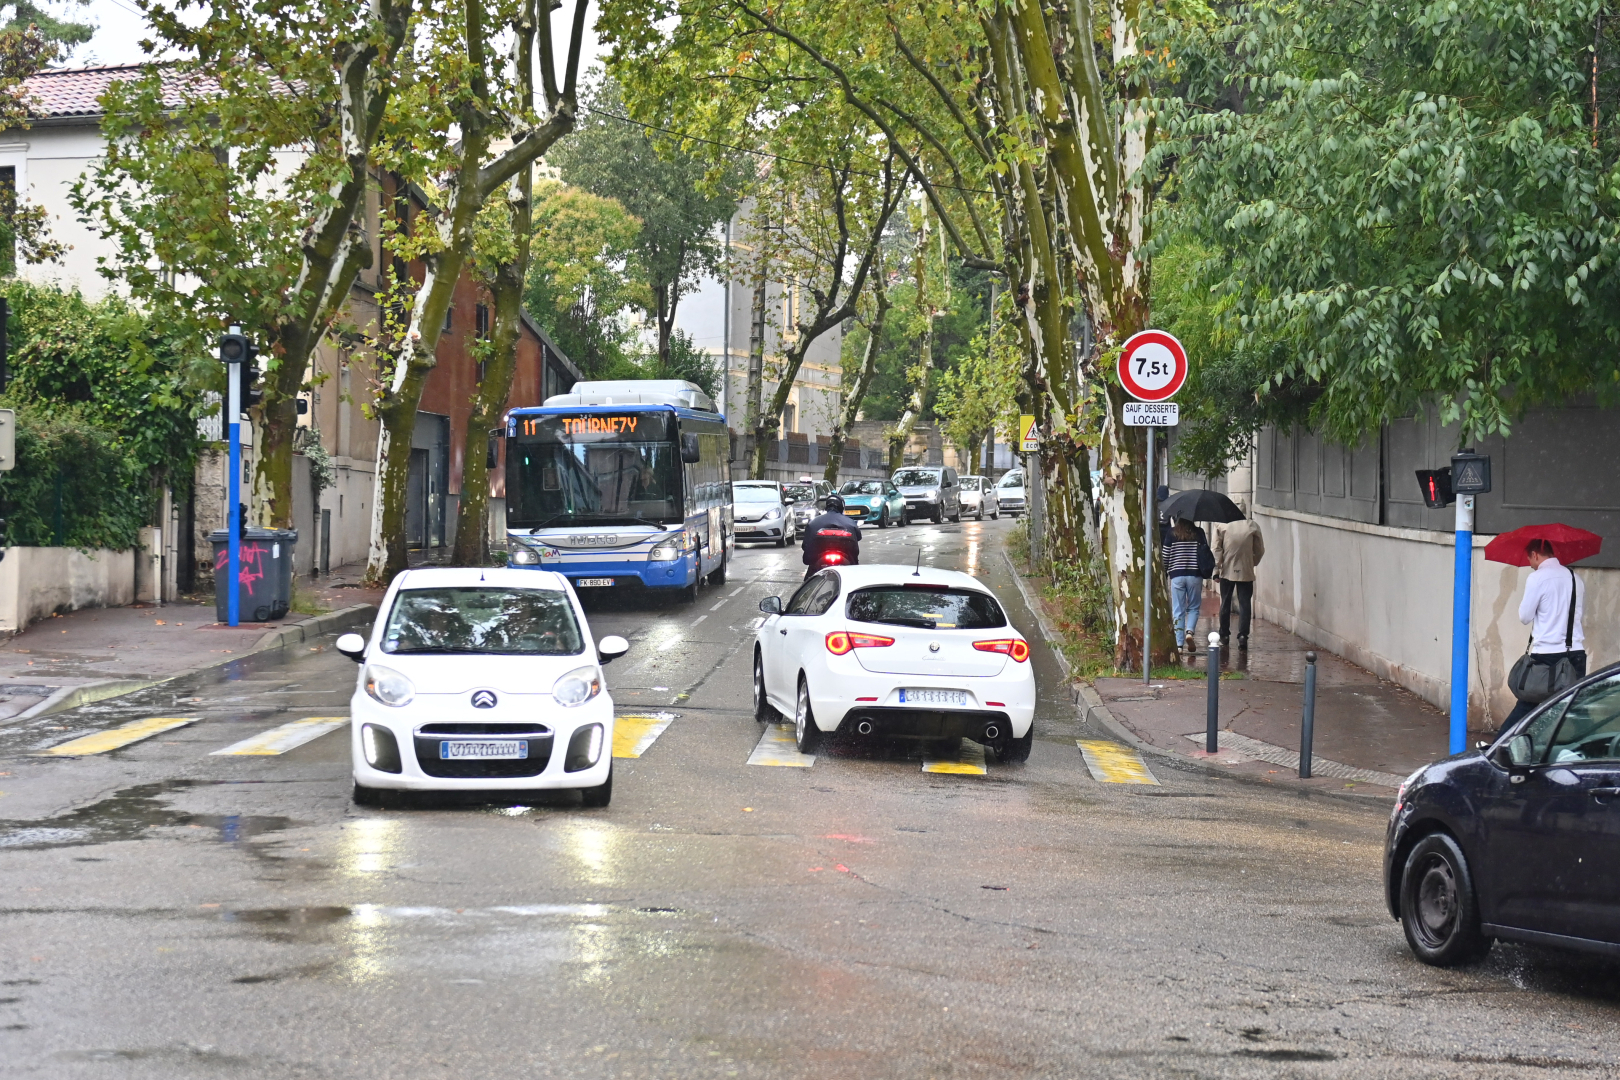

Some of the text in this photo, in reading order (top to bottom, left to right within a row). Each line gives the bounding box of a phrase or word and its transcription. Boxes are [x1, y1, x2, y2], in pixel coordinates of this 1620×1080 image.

[1125, 404, 1177, 413] SAUF DESSERTE
[1133, 415, 1168, 425] LOCALE
[523, 419, 536, 436] 11
[569, 534, 618, 545] IVECO
